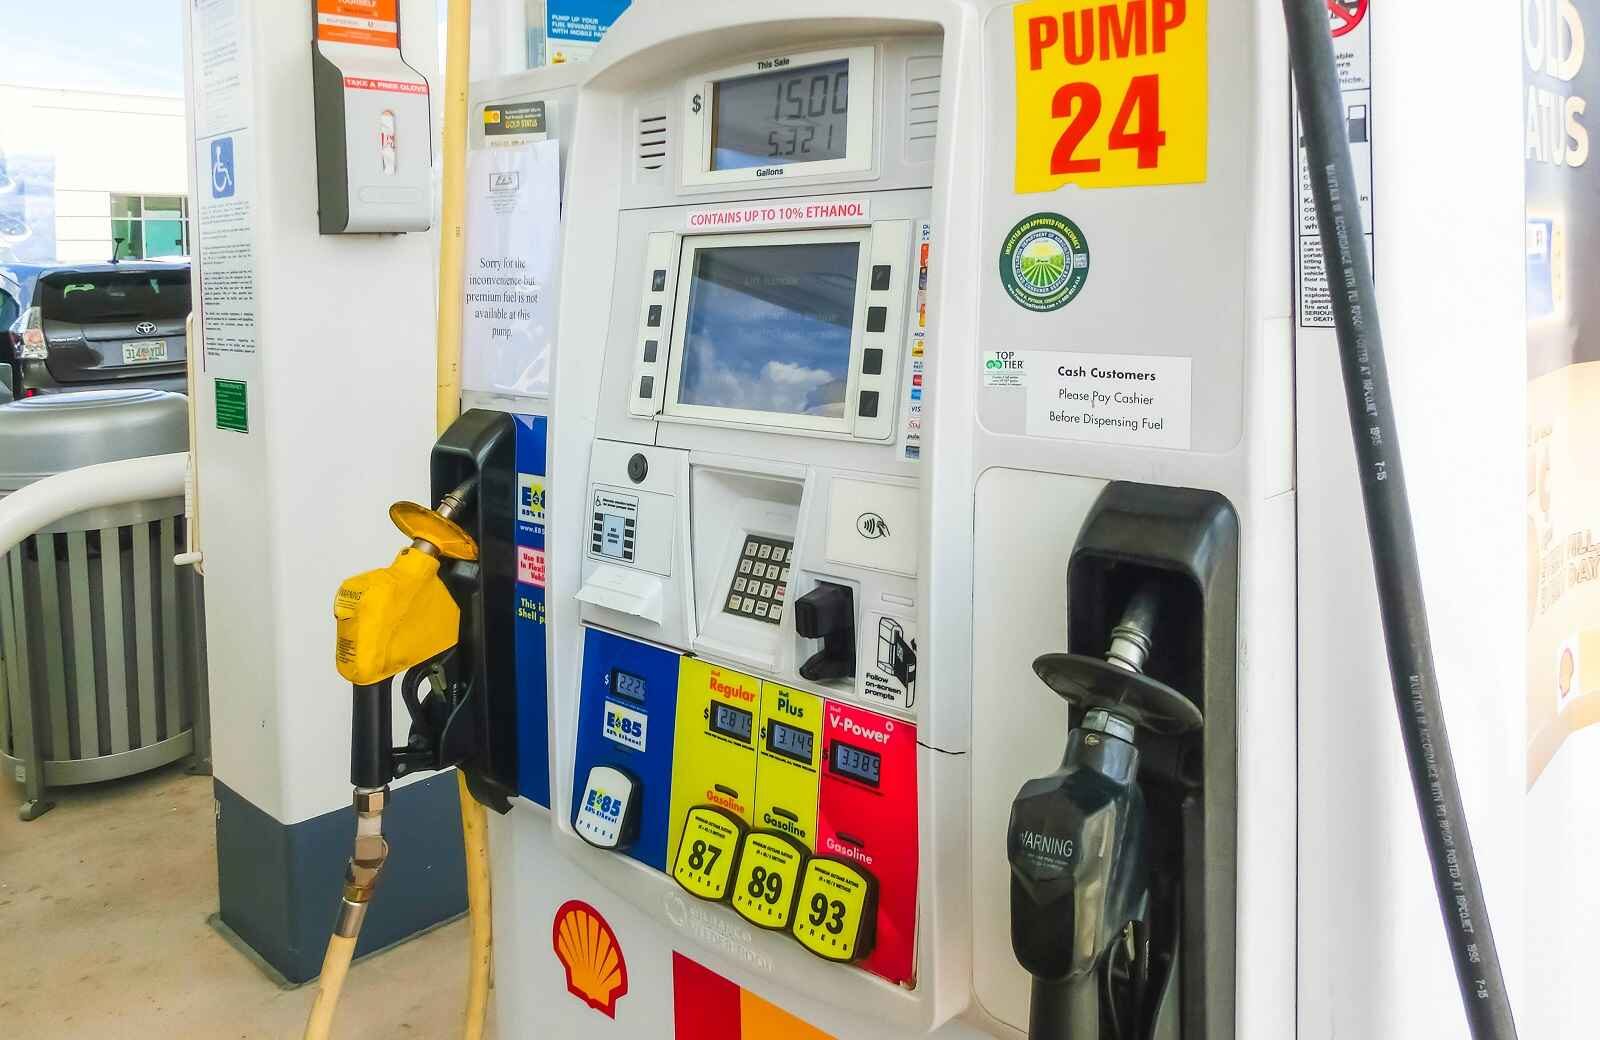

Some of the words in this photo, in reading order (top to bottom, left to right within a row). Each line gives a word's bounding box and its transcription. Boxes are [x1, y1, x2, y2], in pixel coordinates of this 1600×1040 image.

[1028, 0, 1186, 71] PUMP
[756, 59, 772, 71] This
[774, 57, 790, 68] Sale
[347, 79, 367, 87] TAKE
[377, 82, 397, 90] FREE
[692, 93, 702, 115] $
[1050, 74, 1166, 176] 24
[757, 166, 784, 177] Gallons
[1360, 193, 1369, 202] in
[691, 212, 742, 225] CONTAINS
[745, 212, 758, 222] UP
[761, 209, 776, 220] TO
[780, 206, 803, 219] 10%
[806, 202, 863, 218] ETHANOL
[480, 257, 501, 271] Sorry
[503, 257, 513, 269] for
[515, 256, 526, 269] the
[469, 274, 522, 286] inconvenience
[524, 275, 536, 286] but
[466, 291, 501, 304] premium
[503, 291, 517, 304] fuel
[519, 292, 525, 304] is
[527, 294, 538, 304] not
[474, 306, 507, 320] available
[509, 309, 516, 320] at
[518, 307, 530, 321] this
[492, 326, 512, 340] pump.
[995, 351, 1015, 361] TOP
[1004, 360, 1023, 370] TIER
[1058, 366, 1086, 377] Cash
[1090, 368, 1157, 381] Customers
[1058, 389, 1090, 401] Please
[1092, 391, 1111, 404] Pay
[1114, 392, 1154, 405] Cashier
[1049, 411, 1081, 423] Before
[1083, 414, 1139, 431] Dispensing
[1142, 417, 1163, 430] Fuel
[523, 553, 535, 562] Use
[520, 597, 536, 610] This
[518, 608, 537, 621] Shell
[866, 673, 888, 684] Follow
[710, 677, 755, 702] Regular
[865, 690, 895, 701] prompts
[866, 682, 901, 695] on-screen
[703, 707, 709, 719] $
[777, 698, 803, 718] Plus
[760, 727, 766, 739] $
[830, 714, 889, 744] V-Power
[707, 790, 745, 813] Gasoline
[763, 813, 806, 838] Gasoline
[688, 839, 722, 876] 87
[826, 837, 873, 865] Gasoline
[1445, 848, 1460, 879] POSTED
[747, 866, 783, 905] 89
[808, 892, 846, 935] 93
